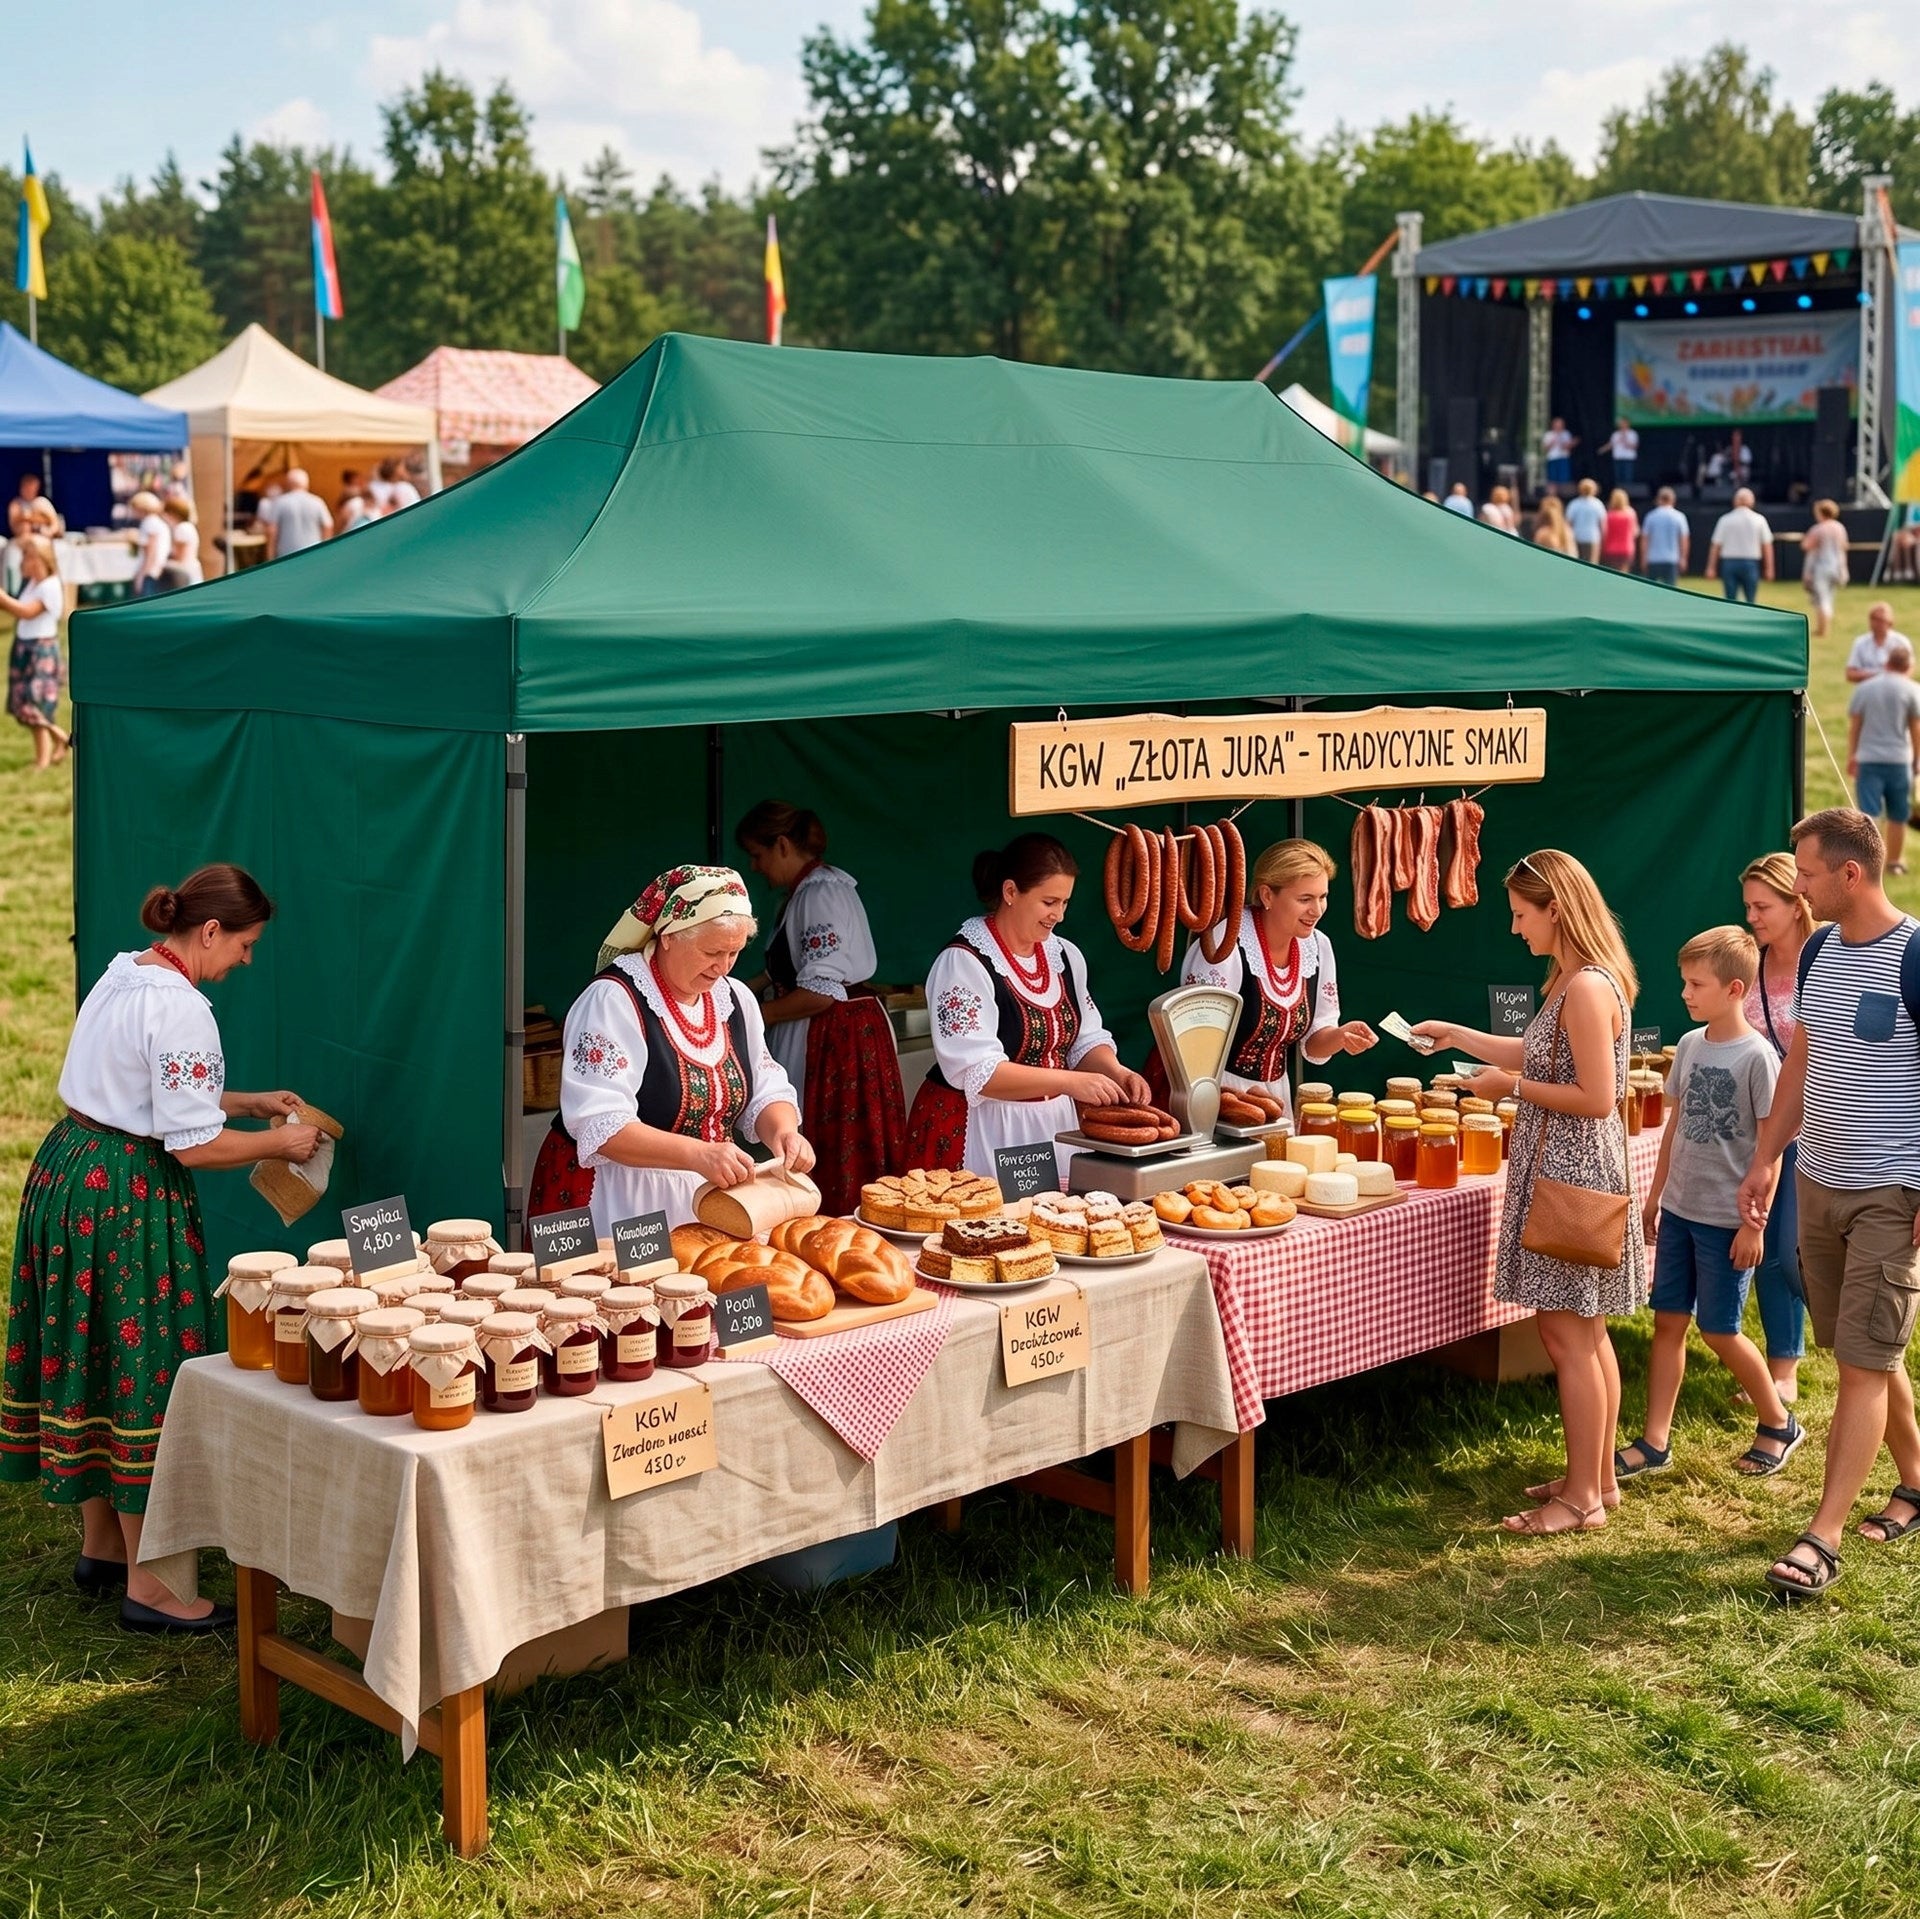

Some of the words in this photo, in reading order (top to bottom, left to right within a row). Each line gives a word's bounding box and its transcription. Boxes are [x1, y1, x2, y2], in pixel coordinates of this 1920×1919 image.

[1039, 741, 1104, 789] KGW
[1317, 728, 1455, 772] TRADYCYJNE
[1464, 727, 1528, 765] SMAKI
[1025, 1304, 1060, 1330] KGW
[635, 1402, 677, 1432] KGW
